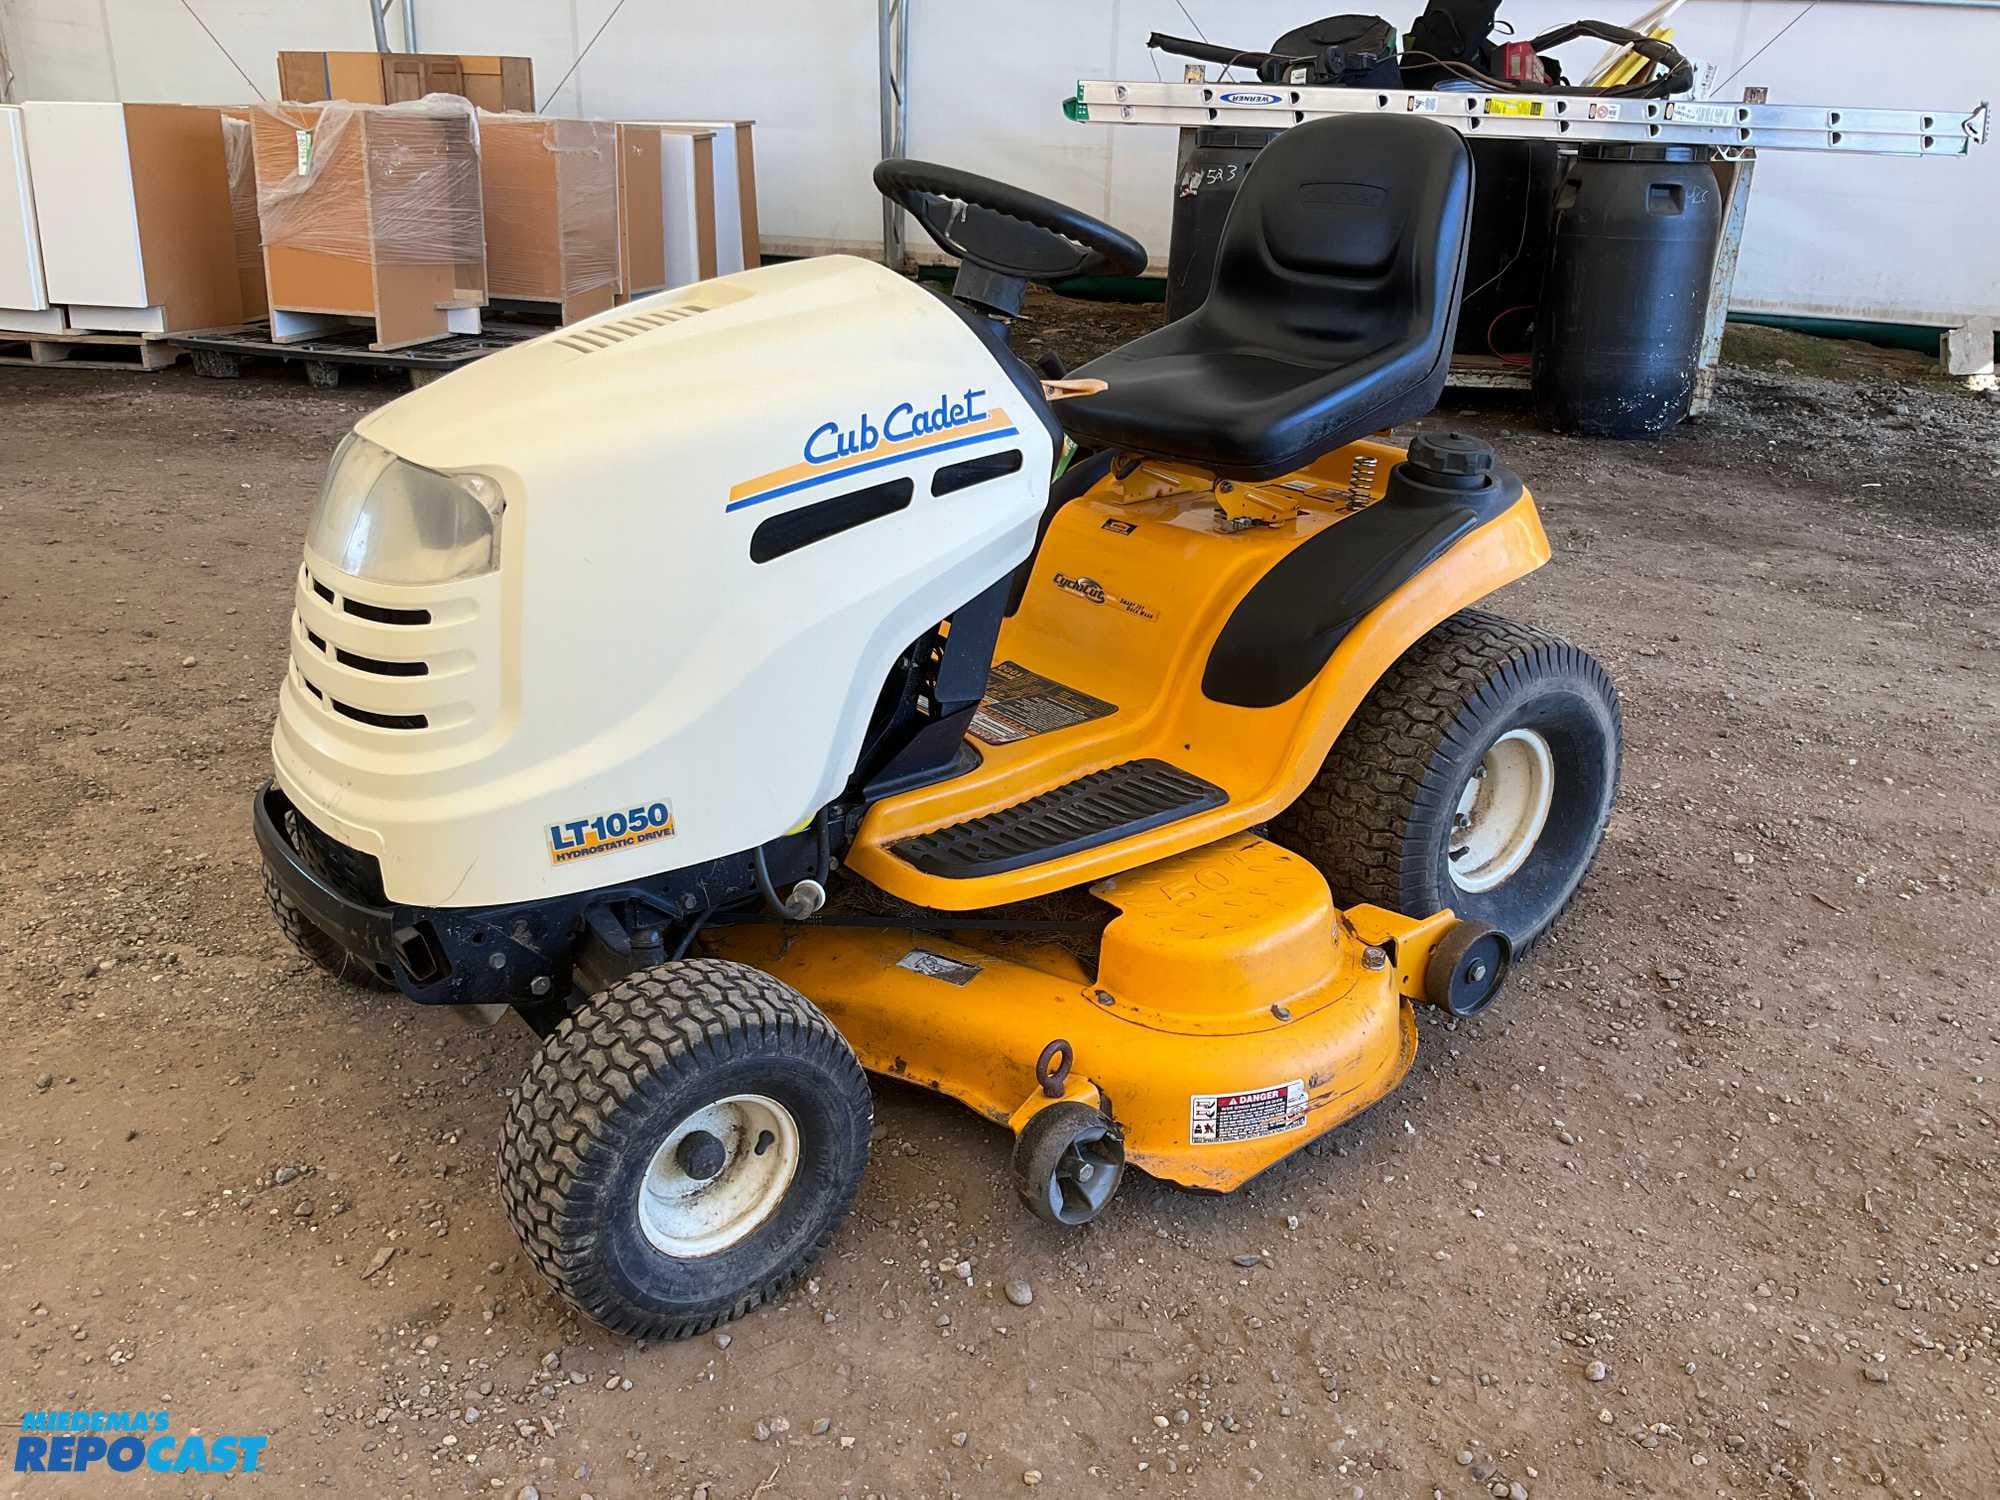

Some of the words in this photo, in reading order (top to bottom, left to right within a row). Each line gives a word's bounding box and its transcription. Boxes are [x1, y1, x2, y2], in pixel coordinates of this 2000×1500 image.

[803, 413, 879, 464] Cub
[883, 388, 987, 443] Cadet
[551, 802, 669, 850] LT1050
[556, 837, 634, 862] HYDROSTATIC
[637, 828, 671, 843] DRIVE
[1239, 1090, 1279, 1104] DANGER
